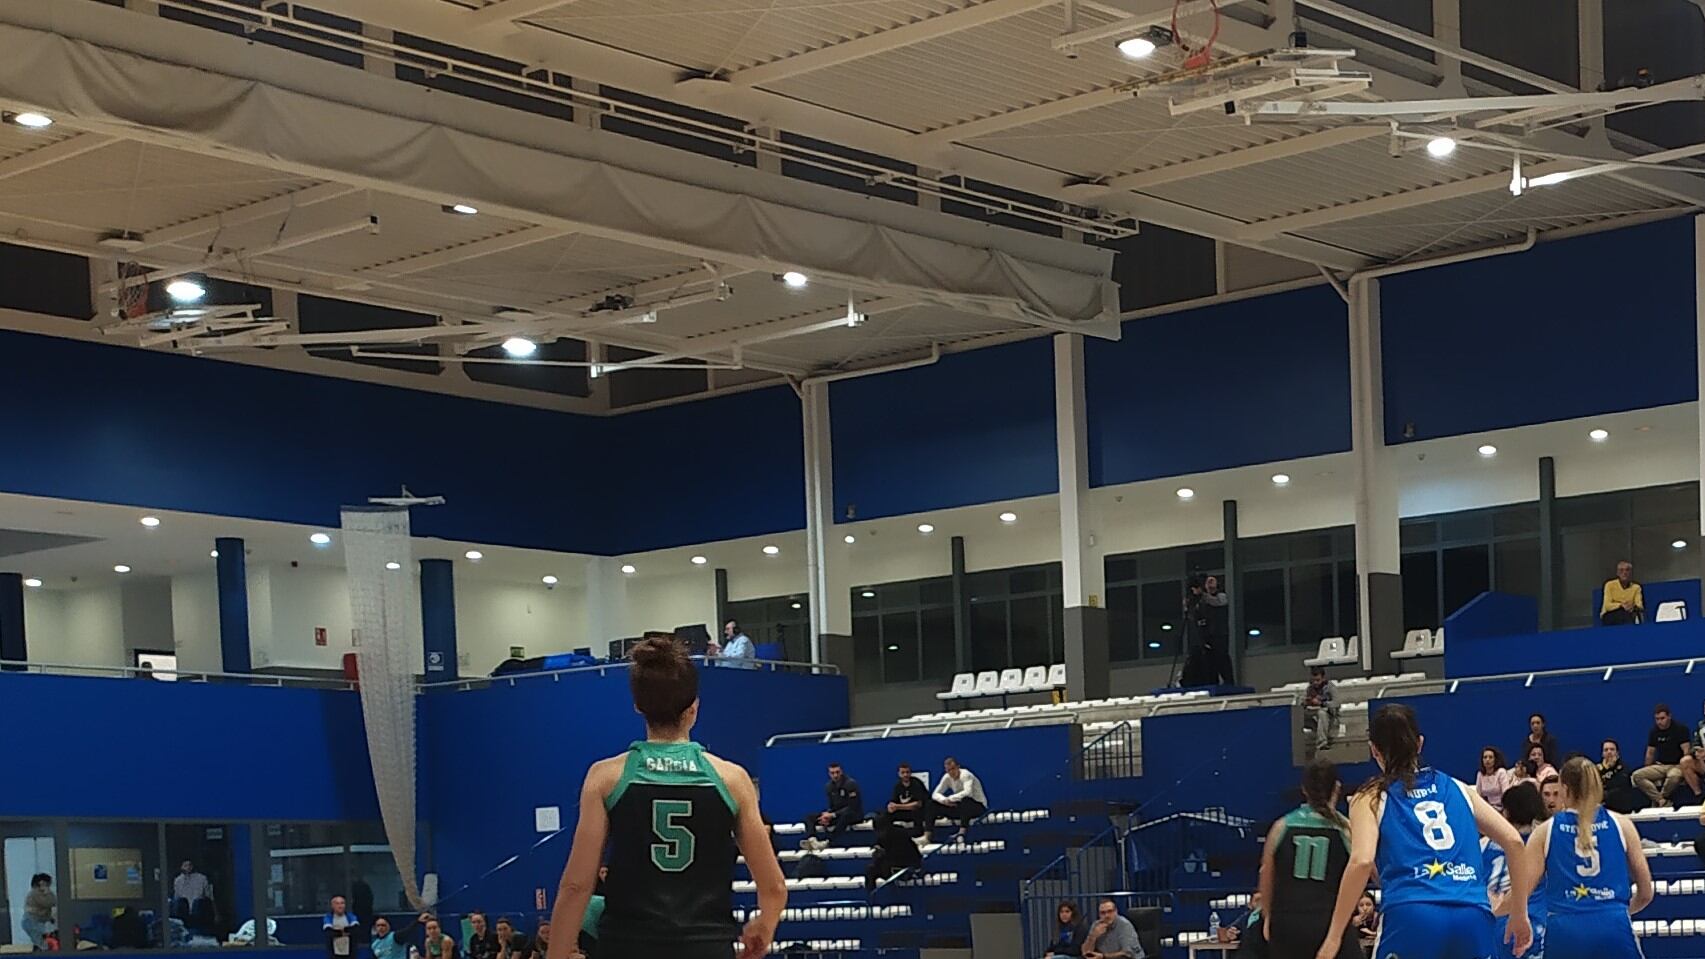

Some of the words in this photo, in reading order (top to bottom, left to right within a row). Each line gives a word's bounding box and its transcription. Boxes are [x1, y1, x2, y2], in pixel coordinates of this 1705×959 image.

[650, 798, 696, 873] 5
[1413, 800, 1456, 851] 8
[1292, 835, 1331, 881] 11
[1446, 862, 1476, 876] Salle
[1574, 835, 1601, 877] 5
